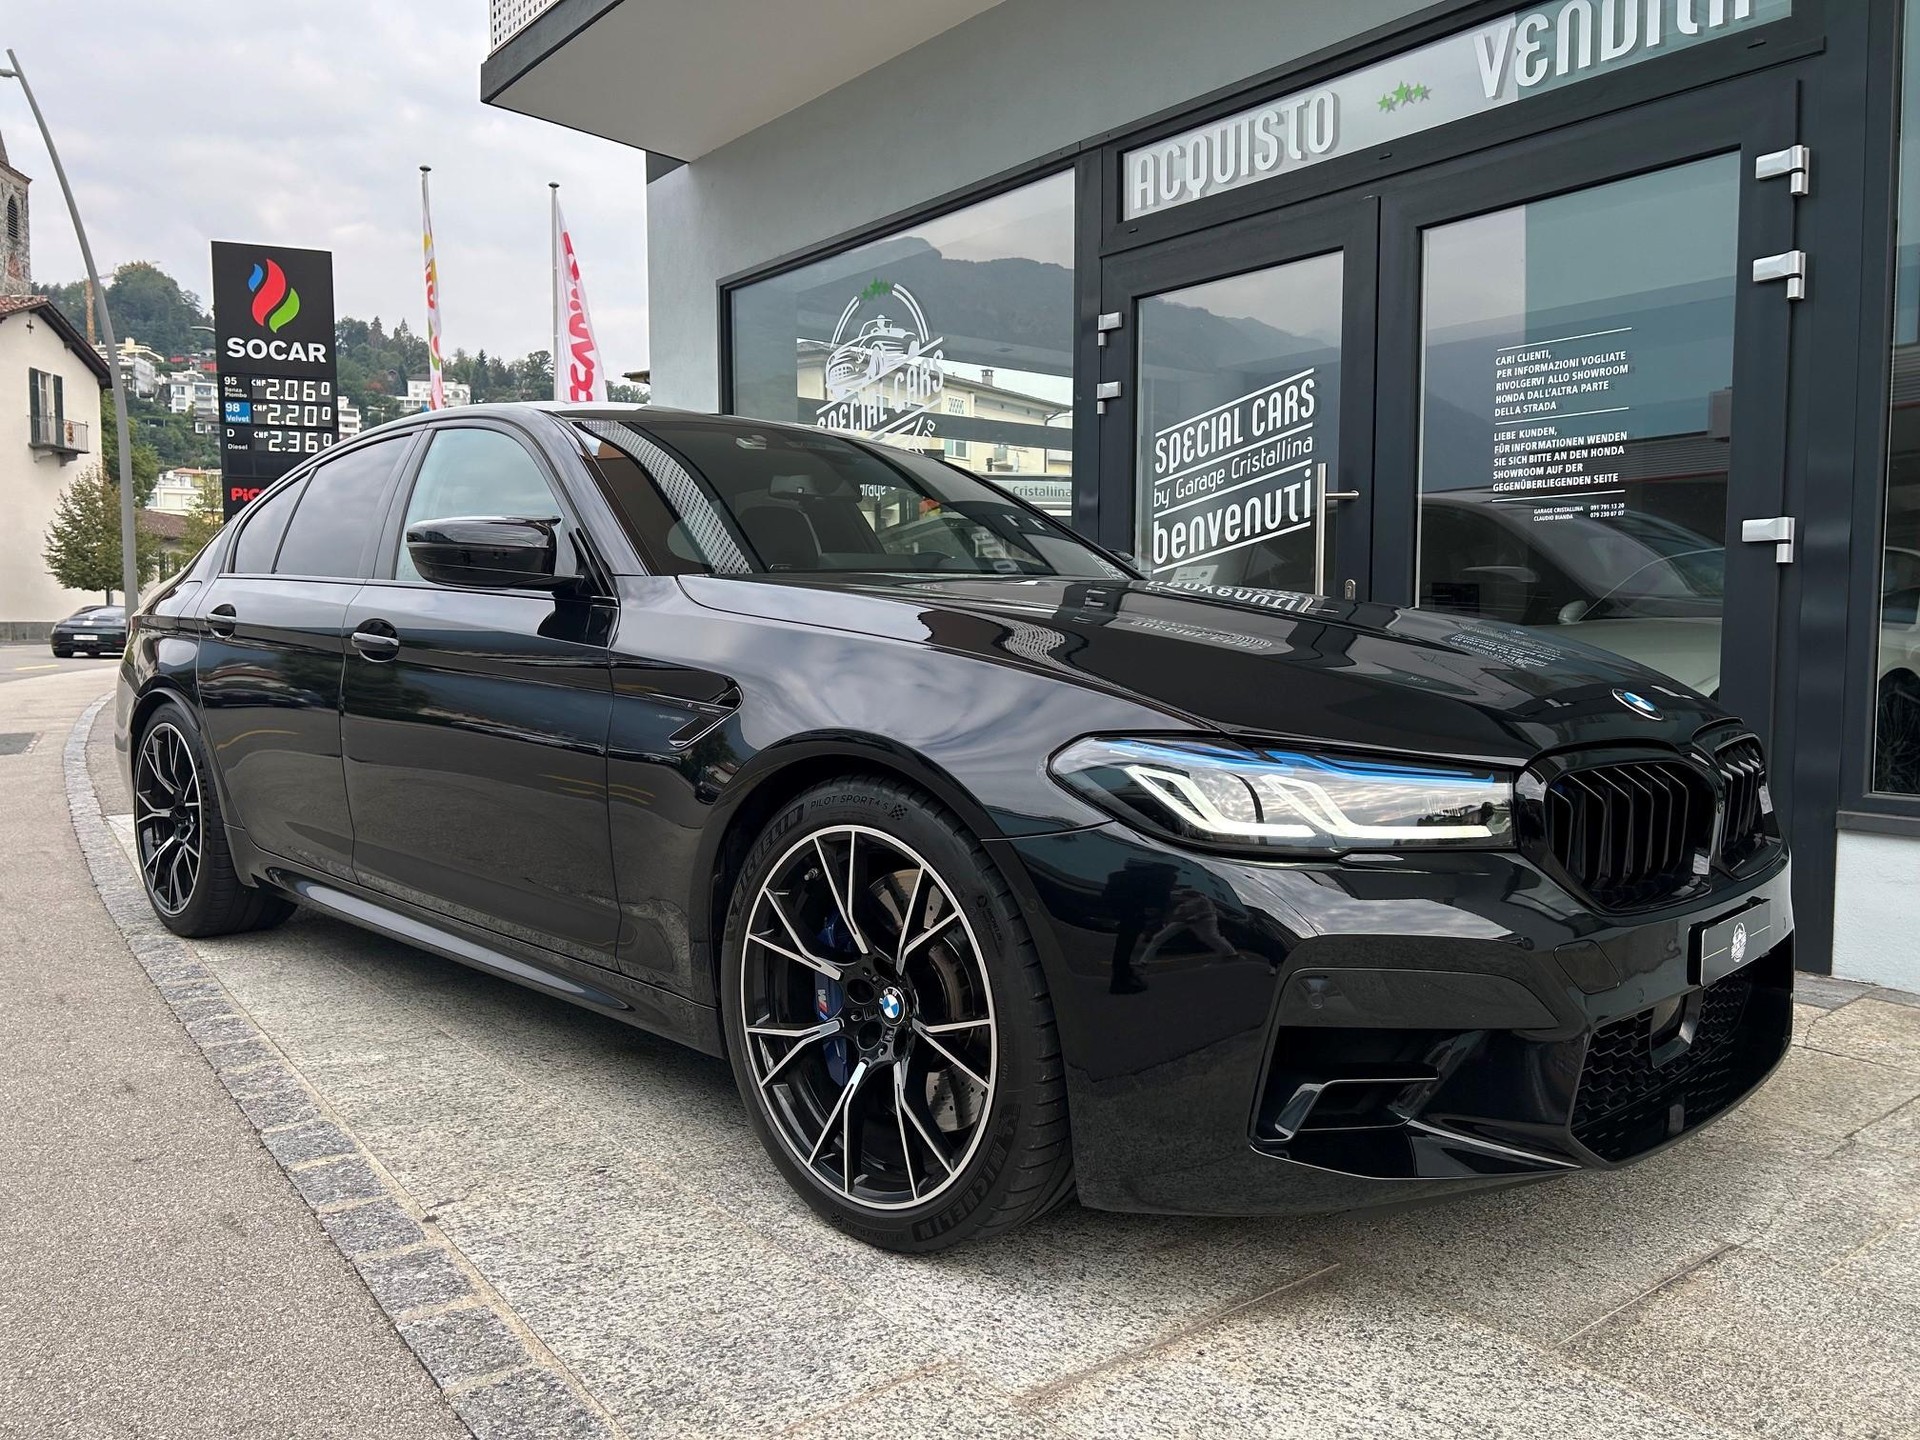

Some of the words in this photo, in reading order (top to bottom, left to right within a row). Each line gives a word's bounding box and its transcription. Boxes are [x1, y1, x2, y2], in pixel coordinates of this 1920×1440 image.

[1133, 89, 1336, 210] ACQUISTO
[226, 337, 327, 363] SOCAR
[1495, 354, 1515, 366] CARI
[1517, 349, 1552, 363] CLIENTI,
[1496, 370, 1513, 379] PER
[1514, 360, 1579, 376] INFORMAZIONI
[1581, 351, 1627, 366] VOGLIATE
[224, 376, 237, 386] 95
[251, 379, 267, 387] CHF
[893, 349, 944, 414] CARS
[1496, 379, 1545, 392] RIVOLGERVI
[1547, 372, 1570, 384] ALLO
[1572, 364, 1629, 381] SHOWROOM
[1495, 393, 1525, 405] HONDA
[1580, 380, 1610, 393] PARTE
[225, 402, 240, 412] 98
[252, 404, 268, 412] CHF
[1494, 405, 1521, 417] DELLA
[1523, 401, 1557, 414] STRADA
[226, 414, 250, 423] Velvet
[1154, 407, 1244, 474] SPECIAL
[1251, 378, 1315, 436] CARS
[226, 428, 235, 438] D
[253, 431, 269, 439] CHF
[1493, 430, 1516, 442] LIEBE
[1518, 426, 1558, 438] KUNDEN,
[1494, 442, 1511, 454] FÜR
[1511, 436, 1585, 453] INFORMATIONEN
[1586, 431, 1628, 445] WENDEN
[1493, 458, 1507, 467] SIE
[1508, 455, 1528, 466] SICH
[1529, 452, 1552, 463] BITTE
[1553, 451, 1568, 461] AN
[1569, 449, 1588, 460] DEN
[1590, 445, 1625, 458] HONDA
[1153, 488, 1171, 509] by
[1175, 467, 1226, 499] Garage
[1231, 436, 1313, 479] Cristallina
[1492, 466, 1544, 480] SHOWROOM
[1546, 464, 1563, 475] AUF
[1565, 462, 1584, 473] DER
[1492, 475, 1595, 492] GEGENÜBERLIEGENDEN
[1593, 472, 1619, 484] SEITE
[1012, 485, 1072, 497] Cristallina
[1152, 468, 1312, 565] benvenuti
[1533, 507, 1553, 515] GARAGE
[1553, 505, 1584, 514] CRISTALLINA
[1533, 514, 1554, 522] CLAUDIO
[1555, 513, 1574, 521] BIANDA
[810, 795, 837, 809] PILOT
[839, 794, 875, 807] SPORT
